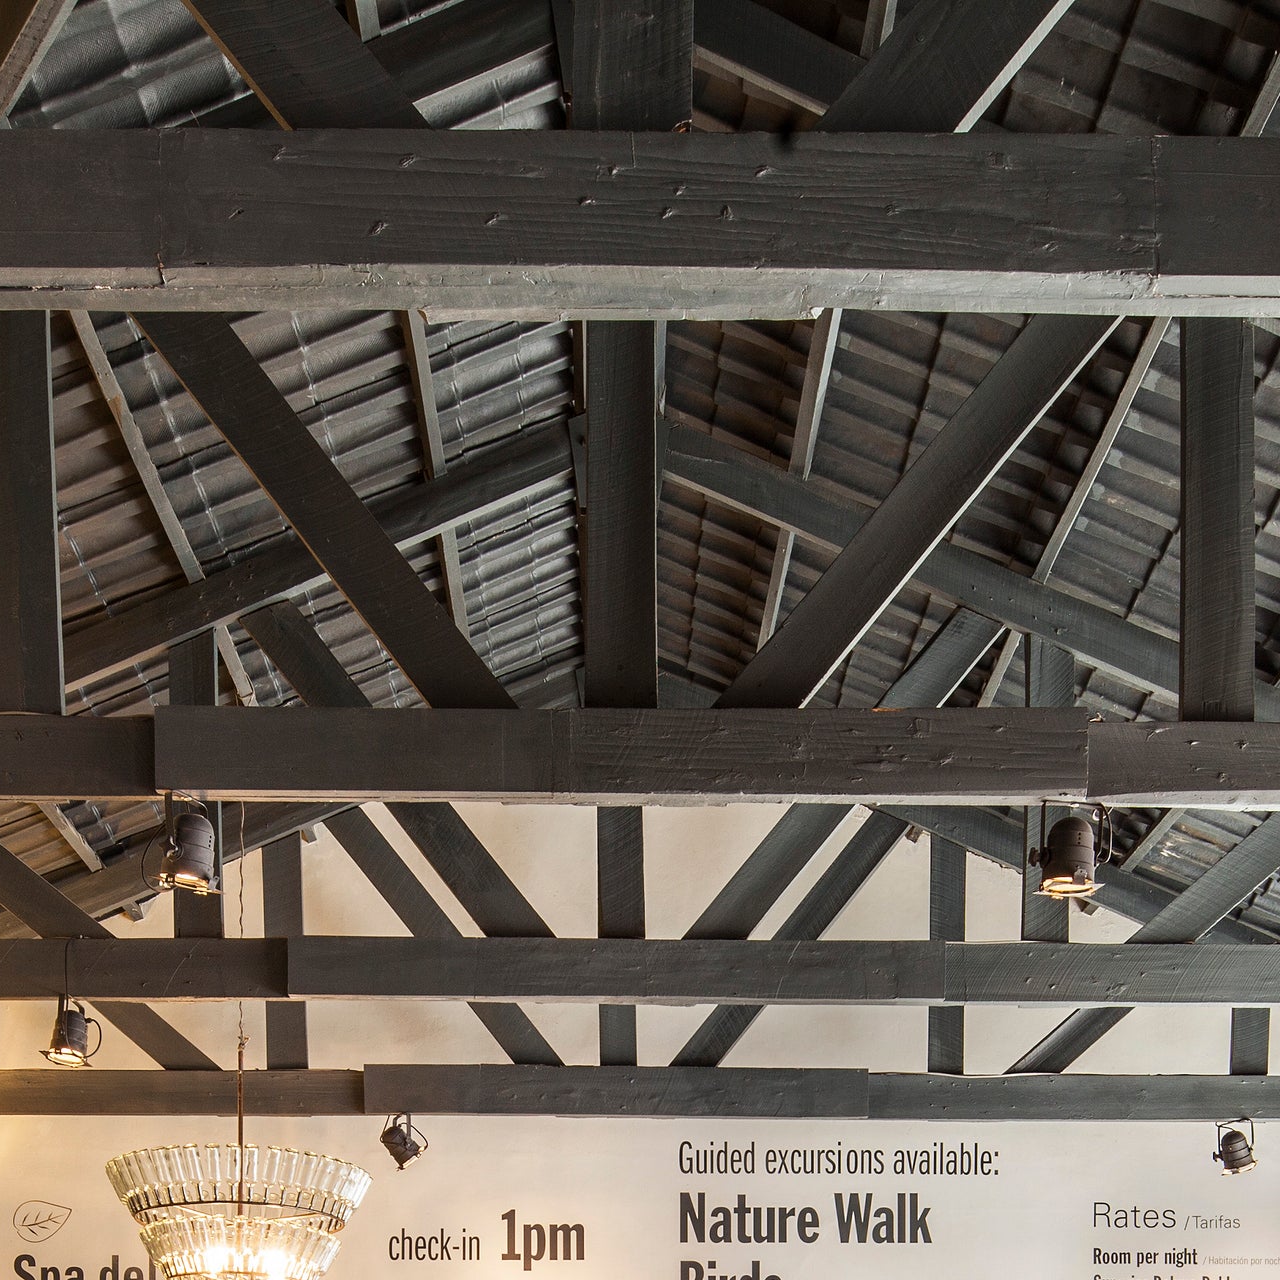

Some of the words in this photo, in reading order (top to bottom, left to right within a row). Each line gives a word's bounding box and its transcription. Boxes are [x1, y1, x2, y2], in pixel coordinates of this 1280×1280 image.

[679, 1141, 756, 1174] Guided
[765, 1141, 884, 1174] excursions
[893, 1142, 998, 1175] available:
[680, 1192, 820, 1244] Nature
[834, 1193, 932, 1244] Walk
[1093, 1202, 1177, 1229] Rates
[389, 1228, 480, 1261] check-in
[502, 1209, 584, 1271] 1pm
[1093, 1248, 1131, 1265] Room
[1137, 1251, 1159, 1267] per
[1164, 1248, 1198, 1267] night
